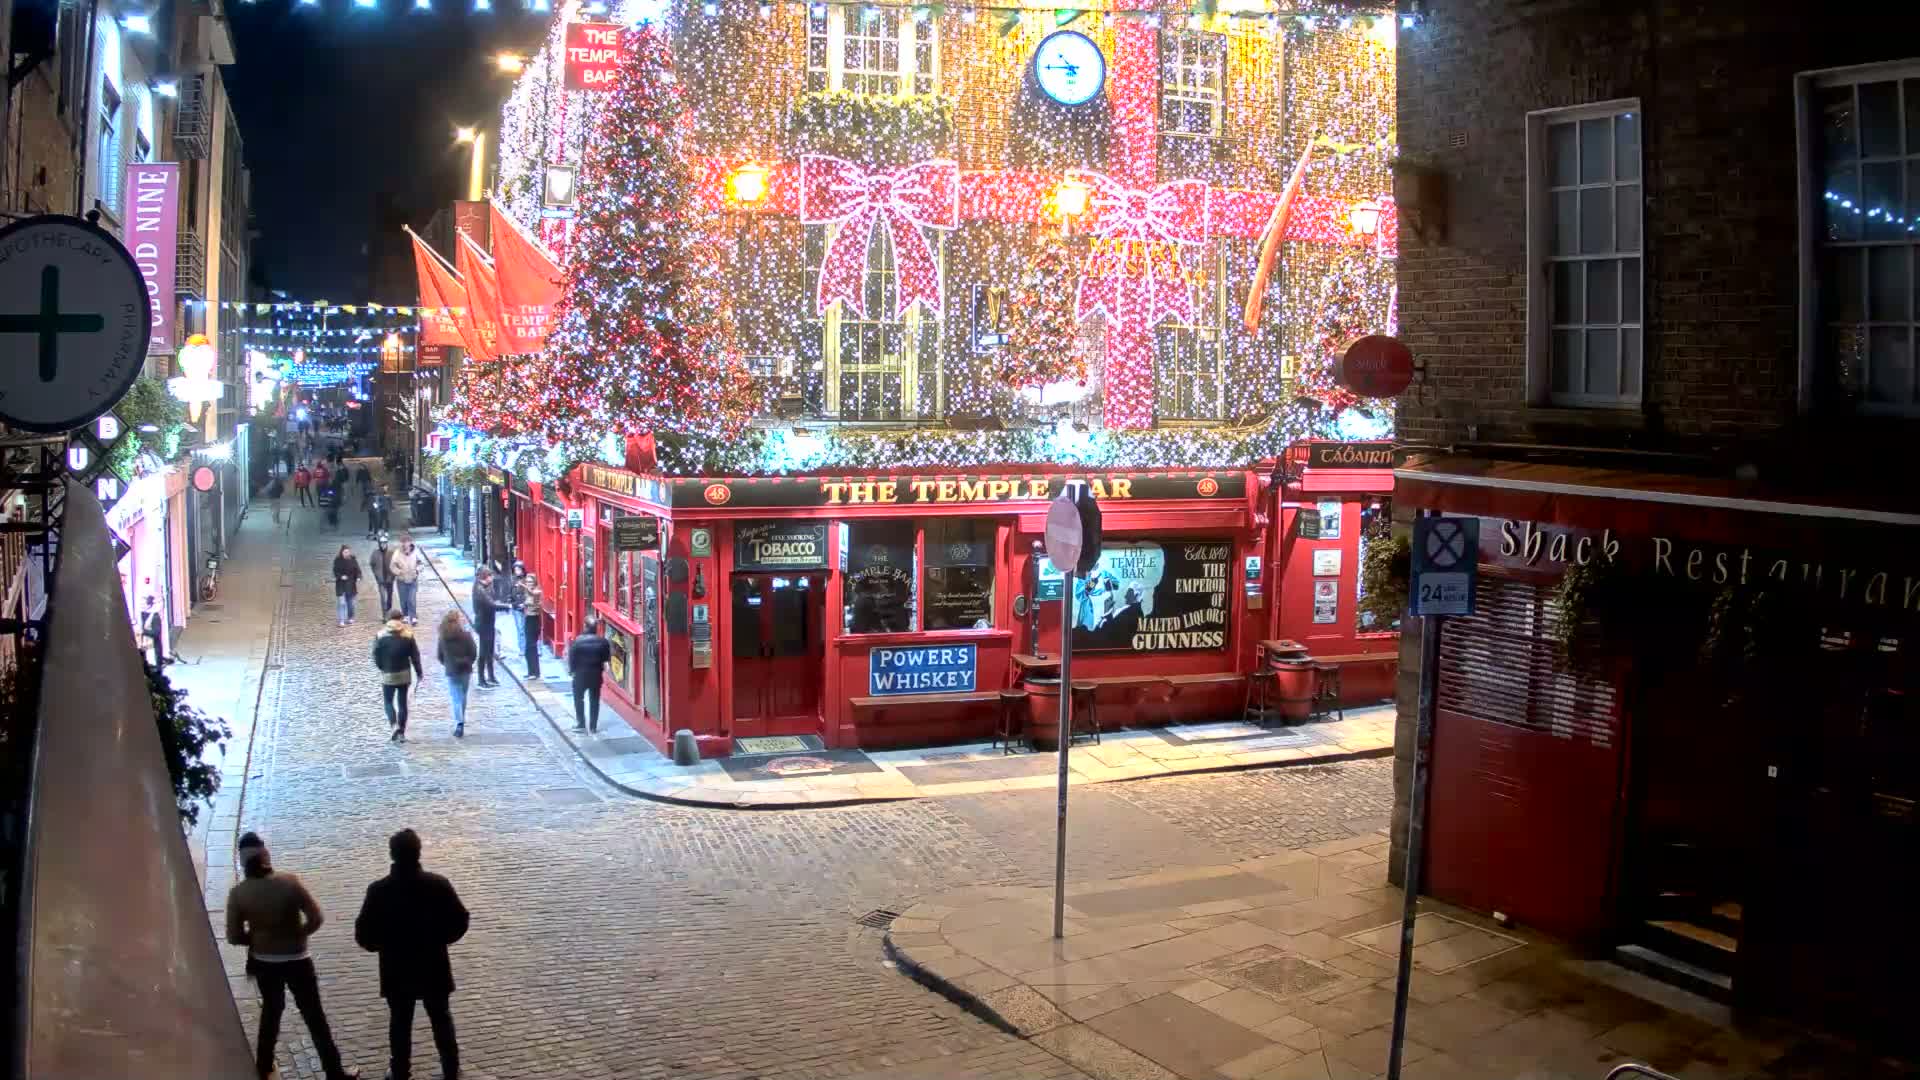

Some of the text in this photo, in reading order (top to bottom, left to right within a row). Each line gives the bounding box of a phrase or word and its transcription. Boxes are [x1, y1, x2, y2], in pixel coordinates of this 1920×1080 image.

[583, 29, 617, 45] THE
[136, 171, 169, 232] NINE
[1087, 237, 1179, 263] MERRY
[1079, 259, 1209, 289] HRISTMAS
[518, 304, 544, 314] THE
[501, 313, 554, 326] TEMPL
[707, 486, 725, 501] 48
[823, 481, 898, 503] THE
[911, 479, 1050, 502] TEMPLE
[1200, 481, 1214, 494] 48
[1123, 546, 1146, 557] THE
[1110, 557, 1157, 569] TEMPLE
[1202, 563, 1226, 578] THE
[1121, 567, 1145, 579] BAR
[1175, 578, 1226, 593] EMPEROR
[1211, 592, 1225, 607] OF
[1421, 584, 1443, 604] 24
[1136, 608, 1227, 632] MALTED LIQUORS
[1131, 631, 1225, 651] GUINNESS
[879, 647, 969, 668] POWER'S
[872, 670, 974, 691] WHISKEY
